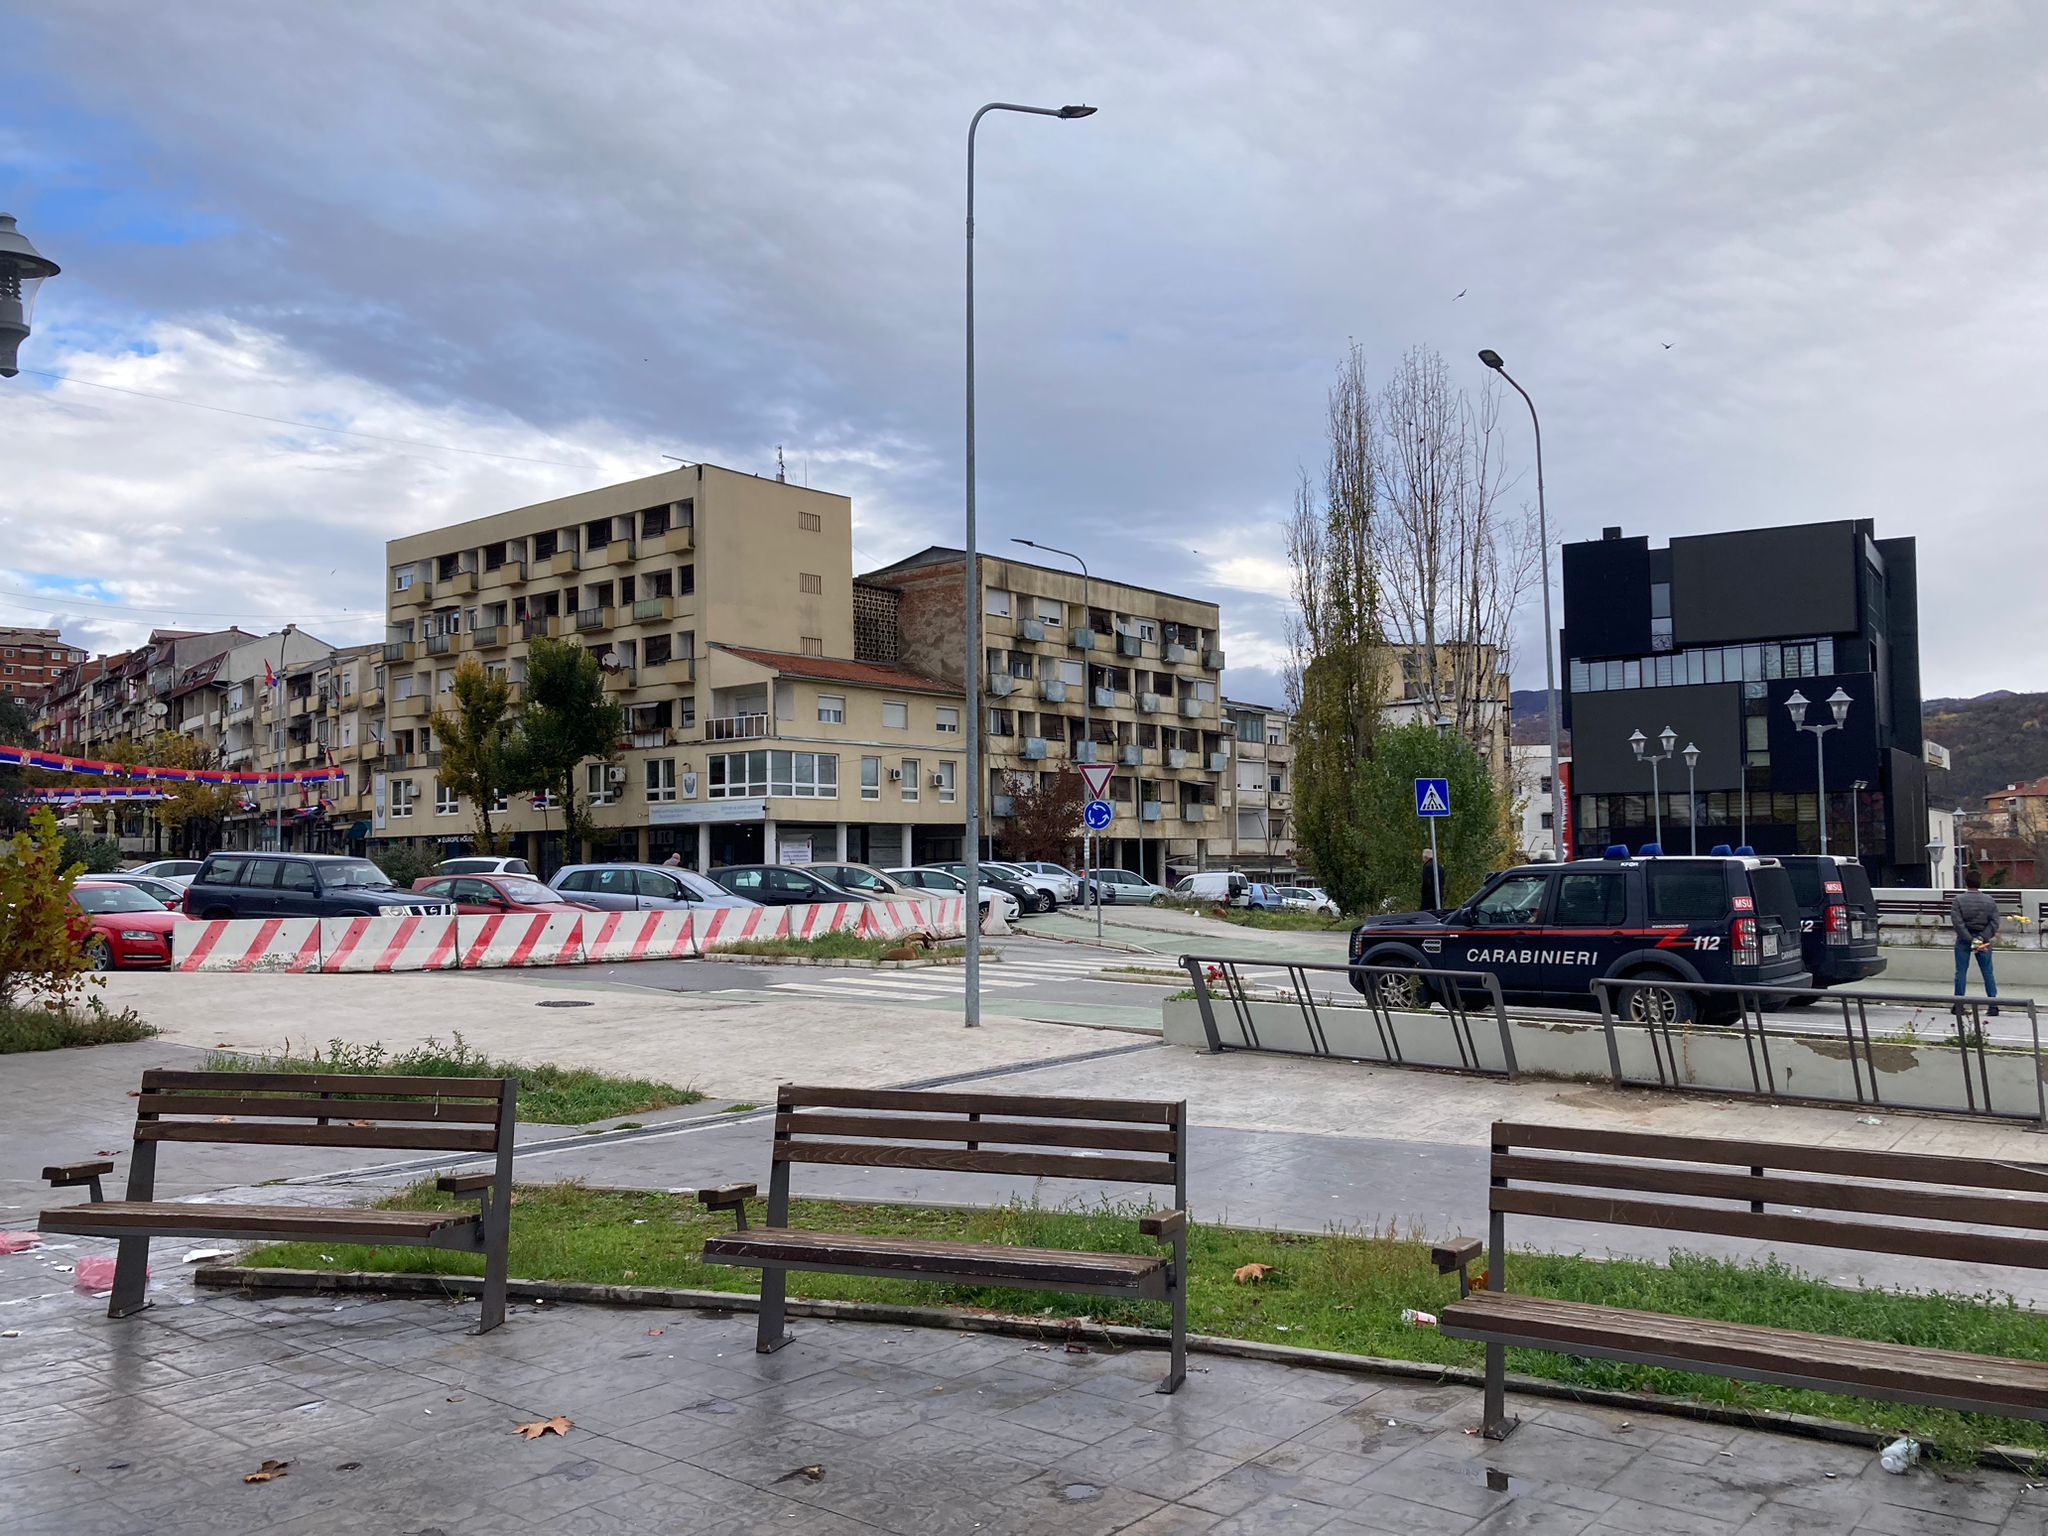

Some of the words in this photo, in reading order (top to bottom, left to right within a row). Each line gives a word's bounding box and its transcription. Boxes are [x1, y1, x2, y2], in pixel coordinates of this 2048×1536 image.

[1826, 883, 1842, 891] MSU
[1734, 898, 1752, 908] MSU
[1694, 936, 1720, 950] 112
[1466, 948, 1598, 965] CARABINIERI
